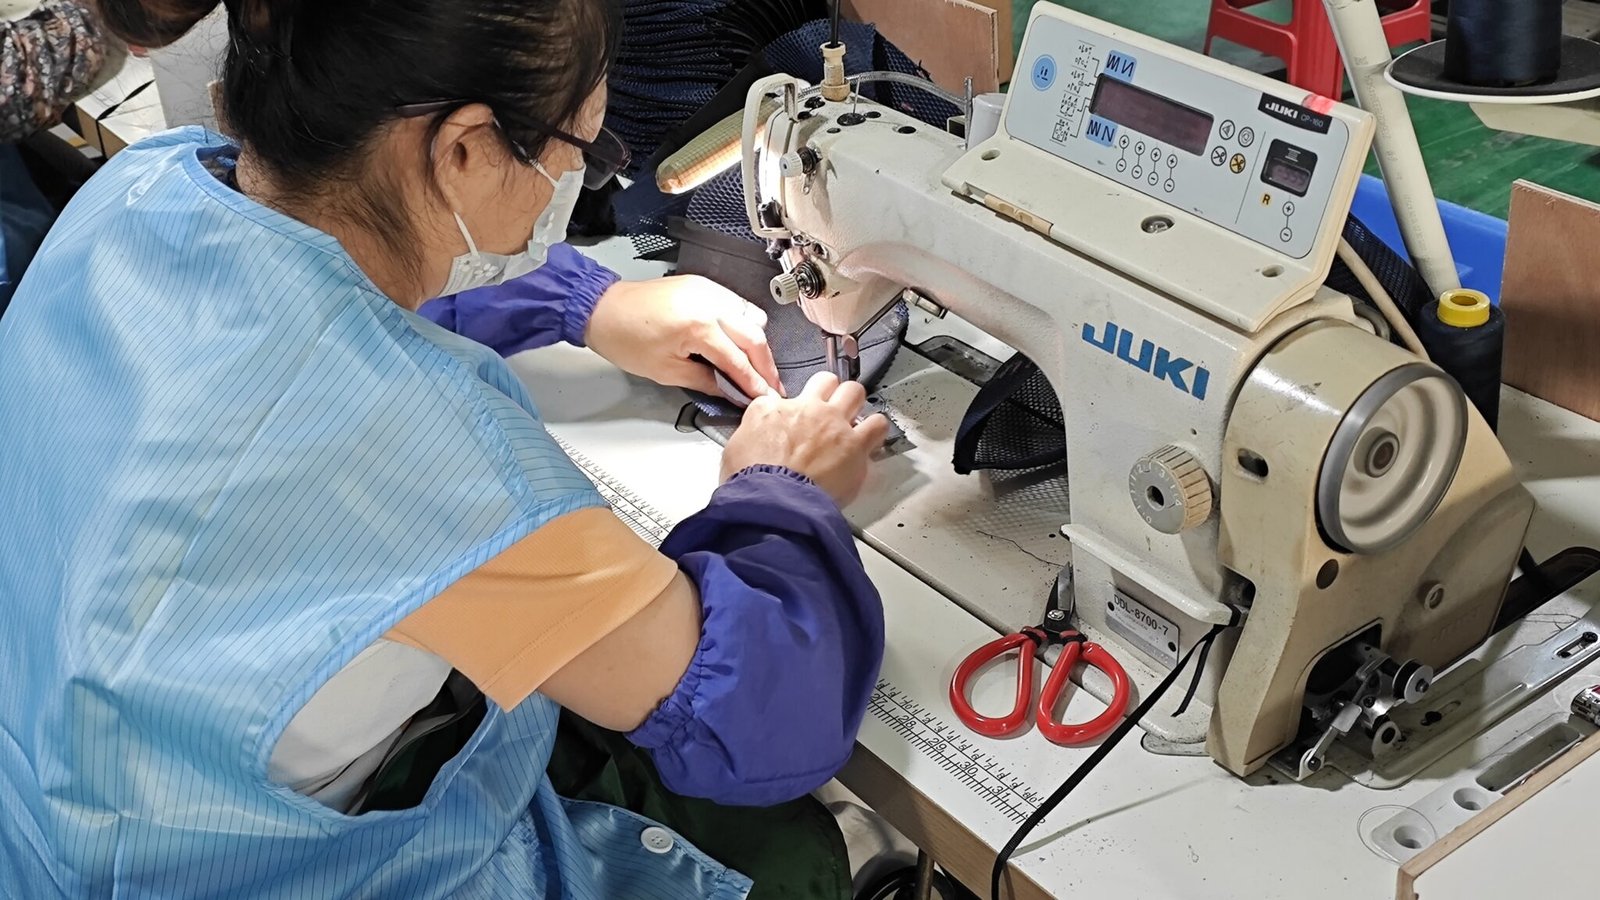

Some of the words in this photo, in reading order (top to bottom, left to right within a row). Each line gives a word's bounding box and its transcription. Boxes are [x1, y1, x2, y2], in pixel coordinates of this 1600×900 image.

[1265, 102, 1298, 119] JUKI
[1300, 113, 1324, 127] CP-160
[1262, 194, 1271, 205] R
[1081, 321, 1211, 401] JUKI
[1114, 594, 1168, 635] DDL-8700-7
[871, 693, 889, 705] 27
[898, 714, 916, 728] 28
[928, 737, 947, 751] 29
[959, 761, 979, 775] 30
[991, 785, 1010, 799] 31
